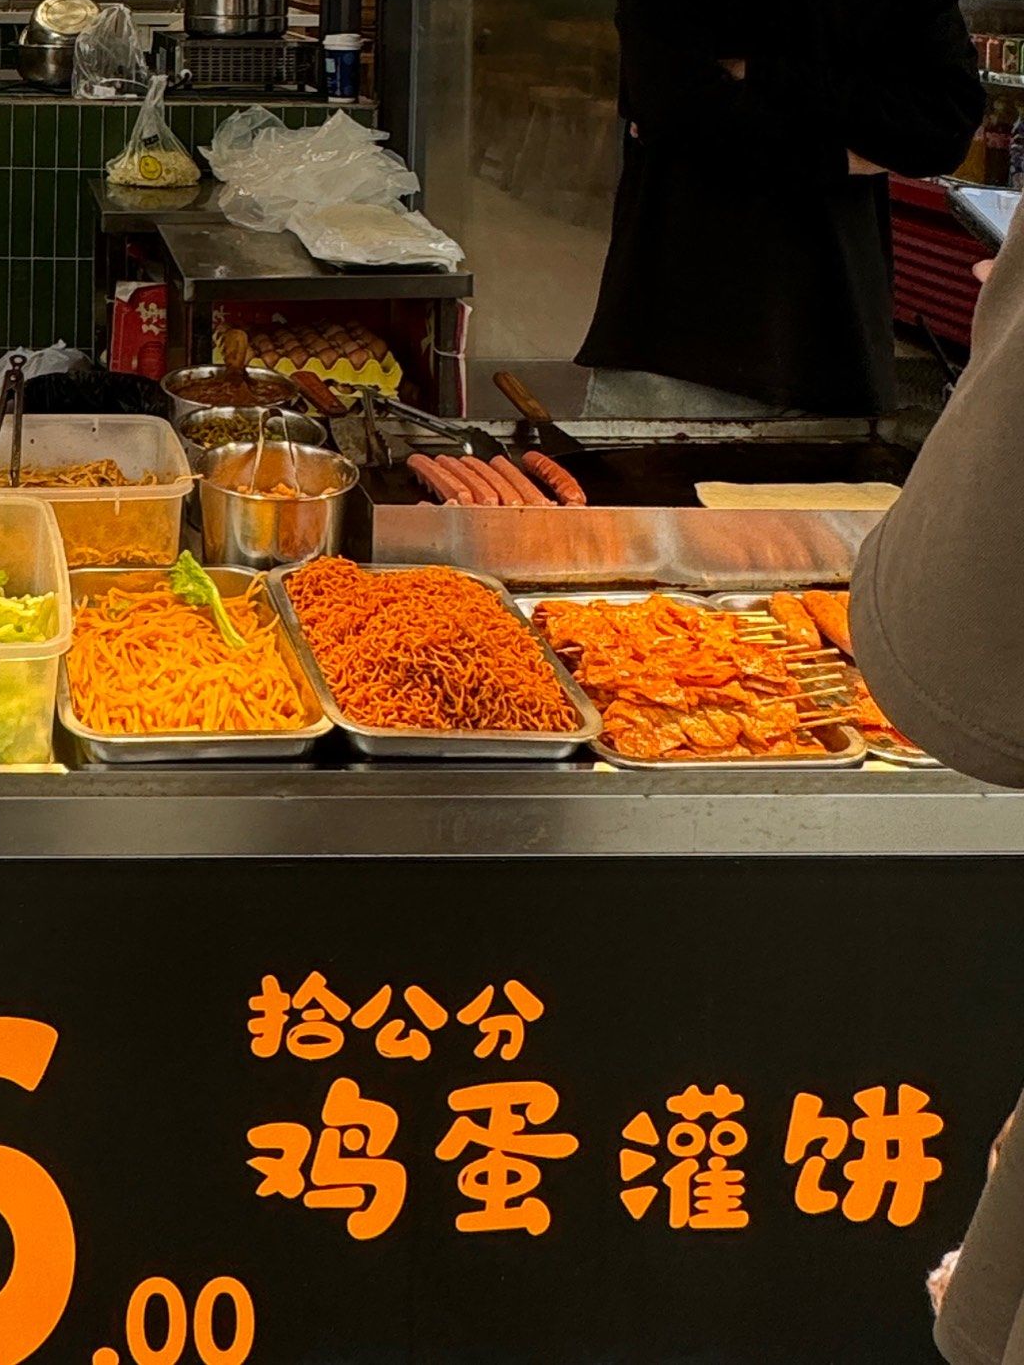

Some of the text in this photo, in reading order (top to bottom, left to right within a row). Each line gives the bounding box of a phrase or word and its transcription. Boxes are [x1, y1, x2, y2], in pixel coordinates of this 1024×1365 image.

[247, 971, 544, 1062] 拾公分
[246, 1076, 944, 1240] 鸡蛋灌饼
